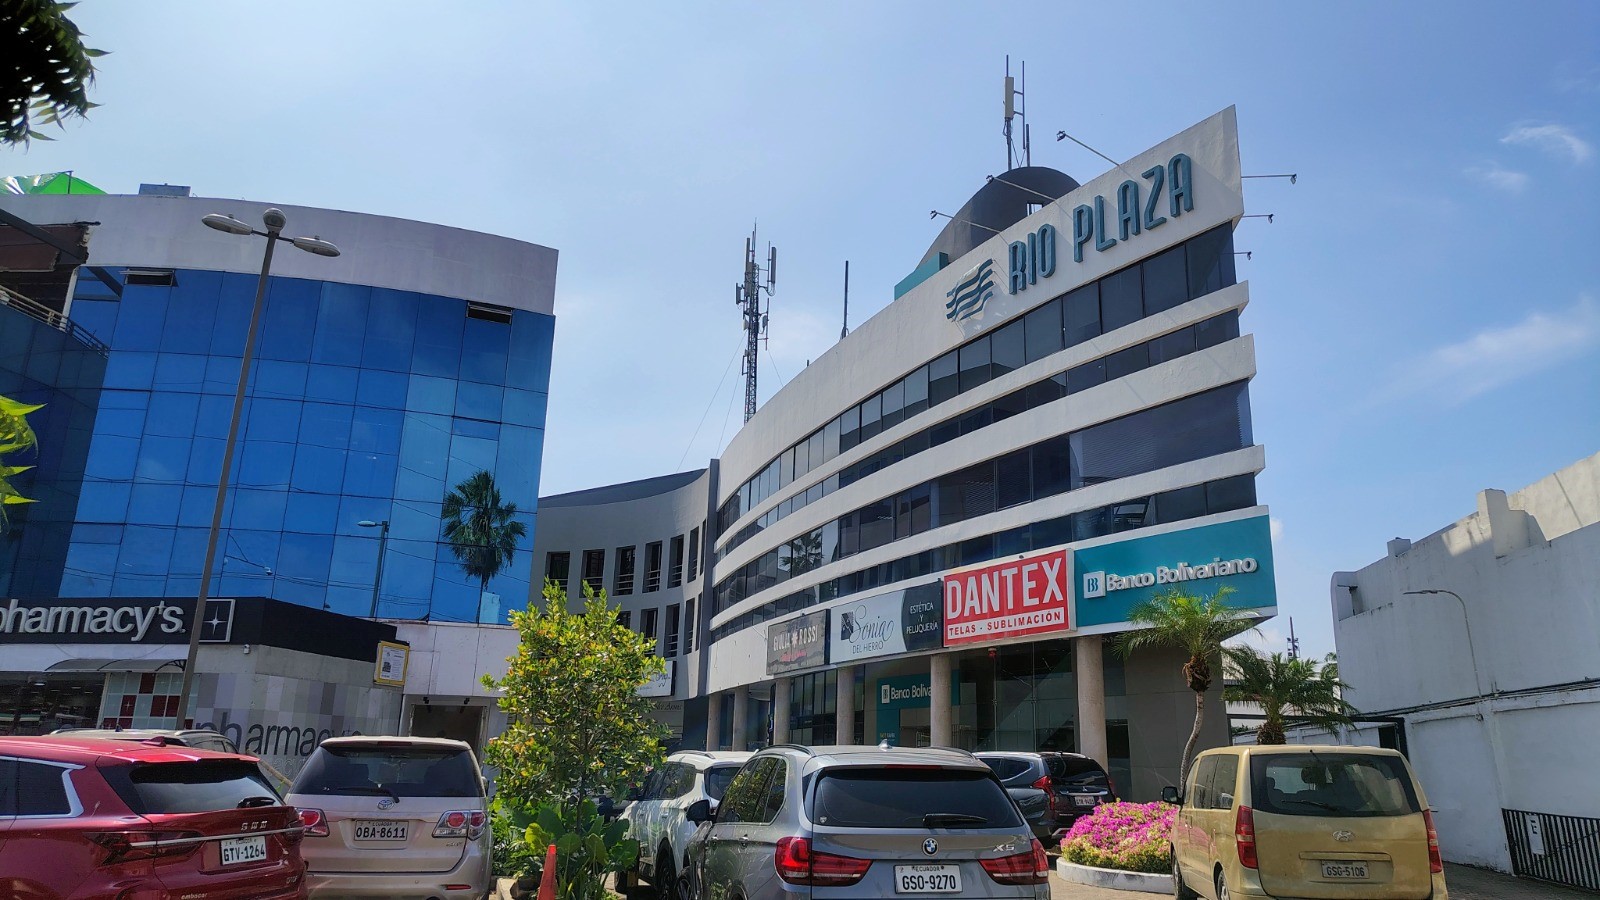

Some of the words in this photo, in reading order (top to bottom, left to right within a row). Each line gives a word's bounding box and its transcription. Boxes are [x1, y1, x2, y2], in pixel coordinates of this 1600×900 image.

[1008, 223, 1056, 295] RIO
[1072, 153, 1194, 263] PLAZA
[1106, 572, 1155, 592] Banco
[1156, 557, 1258, 585] Bolivariano
[946, 557, 1064, 620] DANTEX
[909, 601, 934, 615] ESTÉTICA
[849, 605, 895, 643] Sonia
[919, 614, 924, 622] Y
[949, 624, 976, 636] TELAS
[987, 611, 1061, 631] SUBLIMACIÓN
[798, 625, 818, 646] ROSSI
[906, 621, 939, 635] PELUQUERÍA
[852, 645, 863, 655] DEL
[863, 641, 884, 652] HIERRO
[891, 687, 911, 700] Banco
[911, 683, 931, 698] Boliva
[356, 826, 406, 838] OBA-8611
[223, 845, 265, 862] GTV-1264
[993, 844, 1015, 852] X5
[1326, 866, 1365, 877] GSG-5106
[902, 875, 956, 890] GSO-9270
